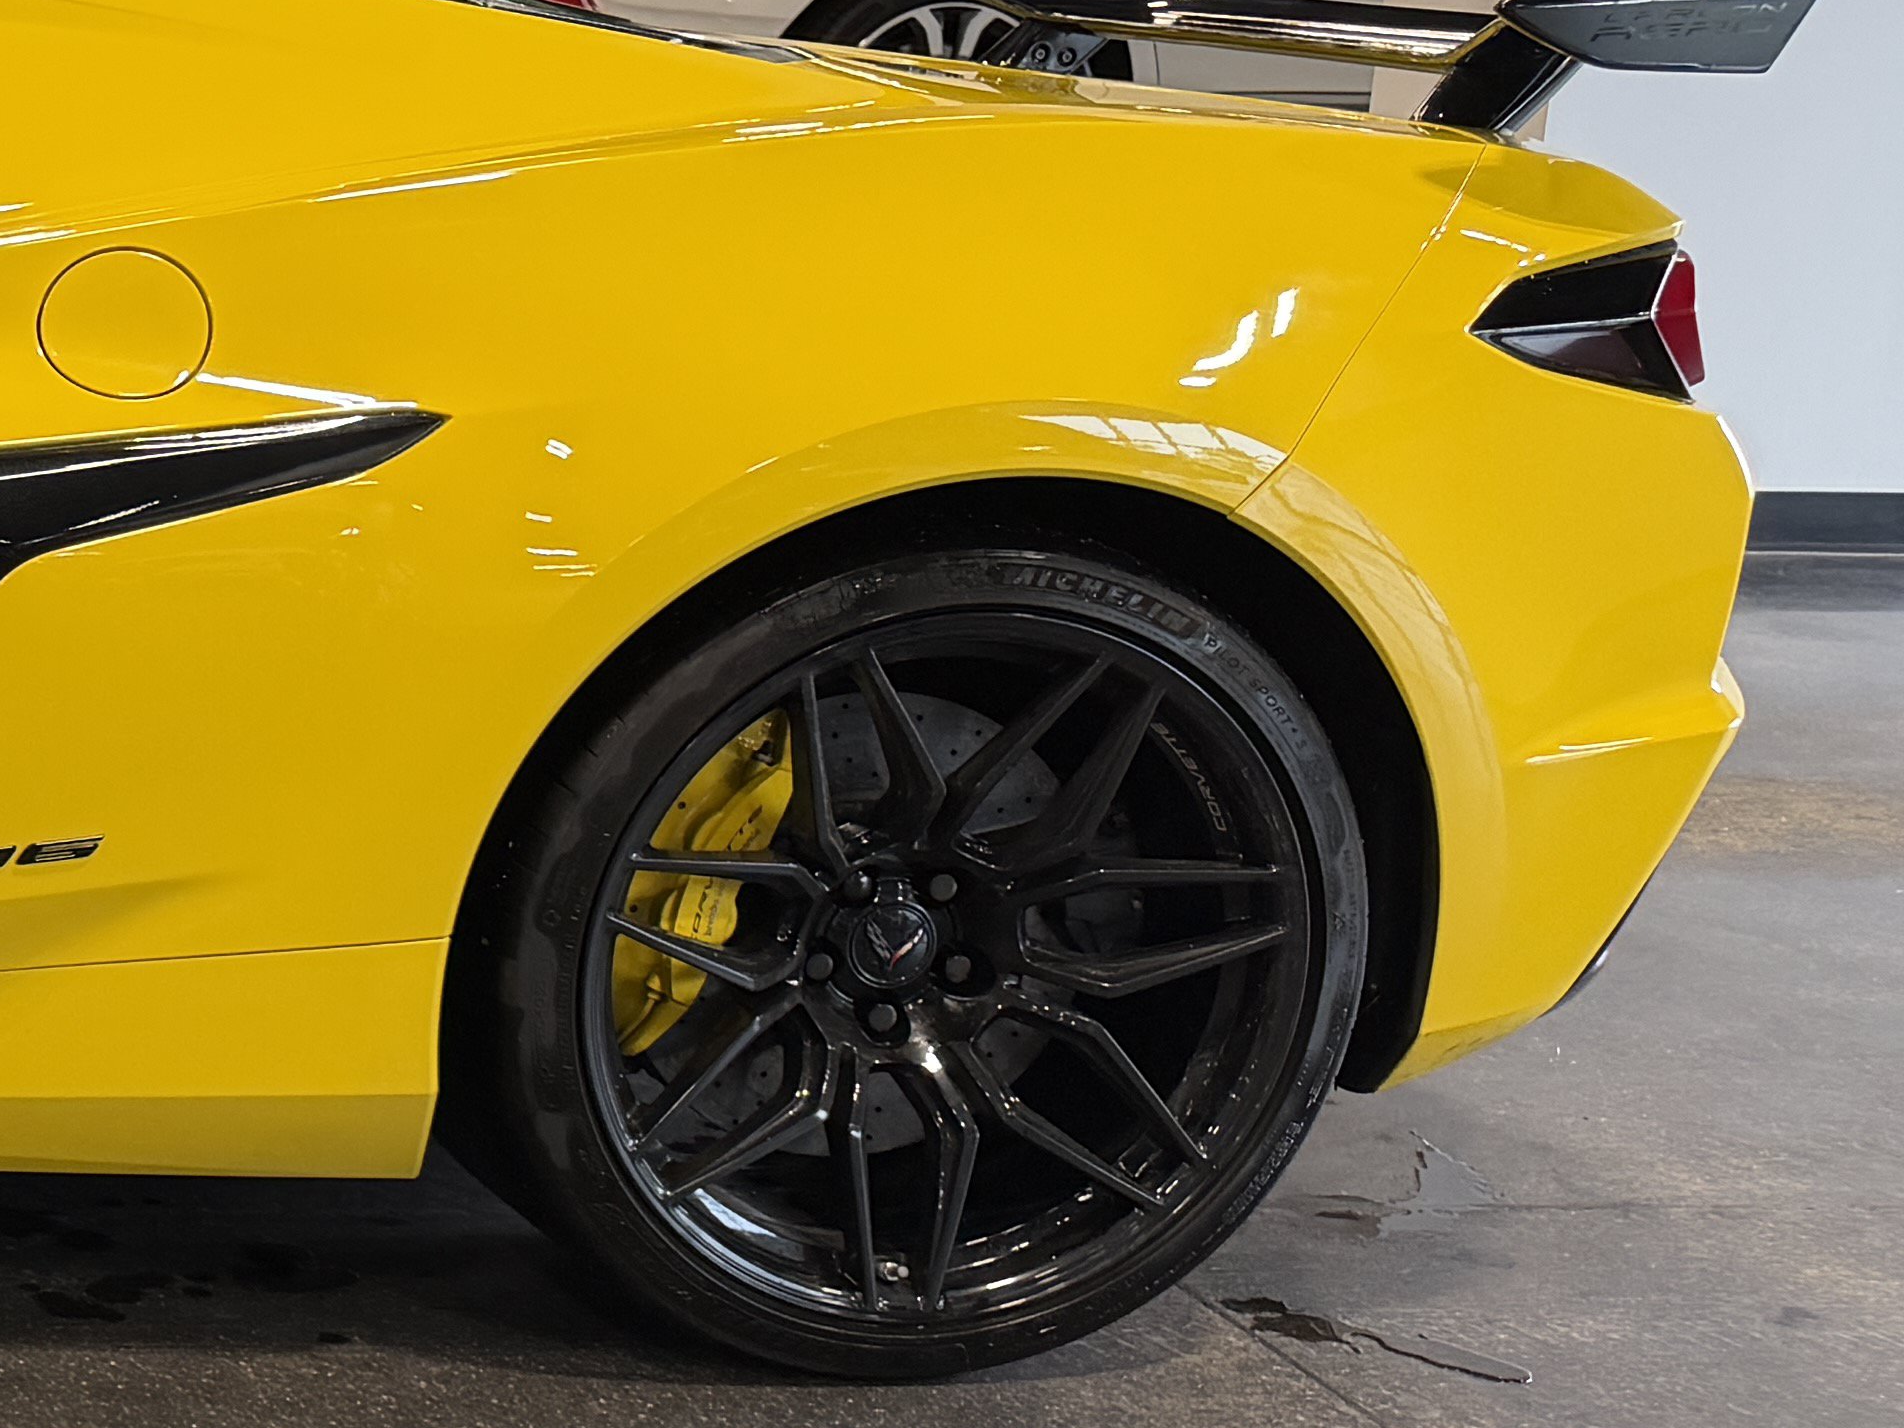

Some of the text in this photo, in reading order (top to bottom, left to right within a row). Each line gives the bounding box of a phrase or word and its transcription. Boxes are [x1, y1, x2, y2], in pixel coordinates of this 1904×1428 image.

[1204, 635, 1251, 678] PILOT
[1248, 677, 1293, 725] SPORT
[1149, 721, 1228, 833] CORVETTE
